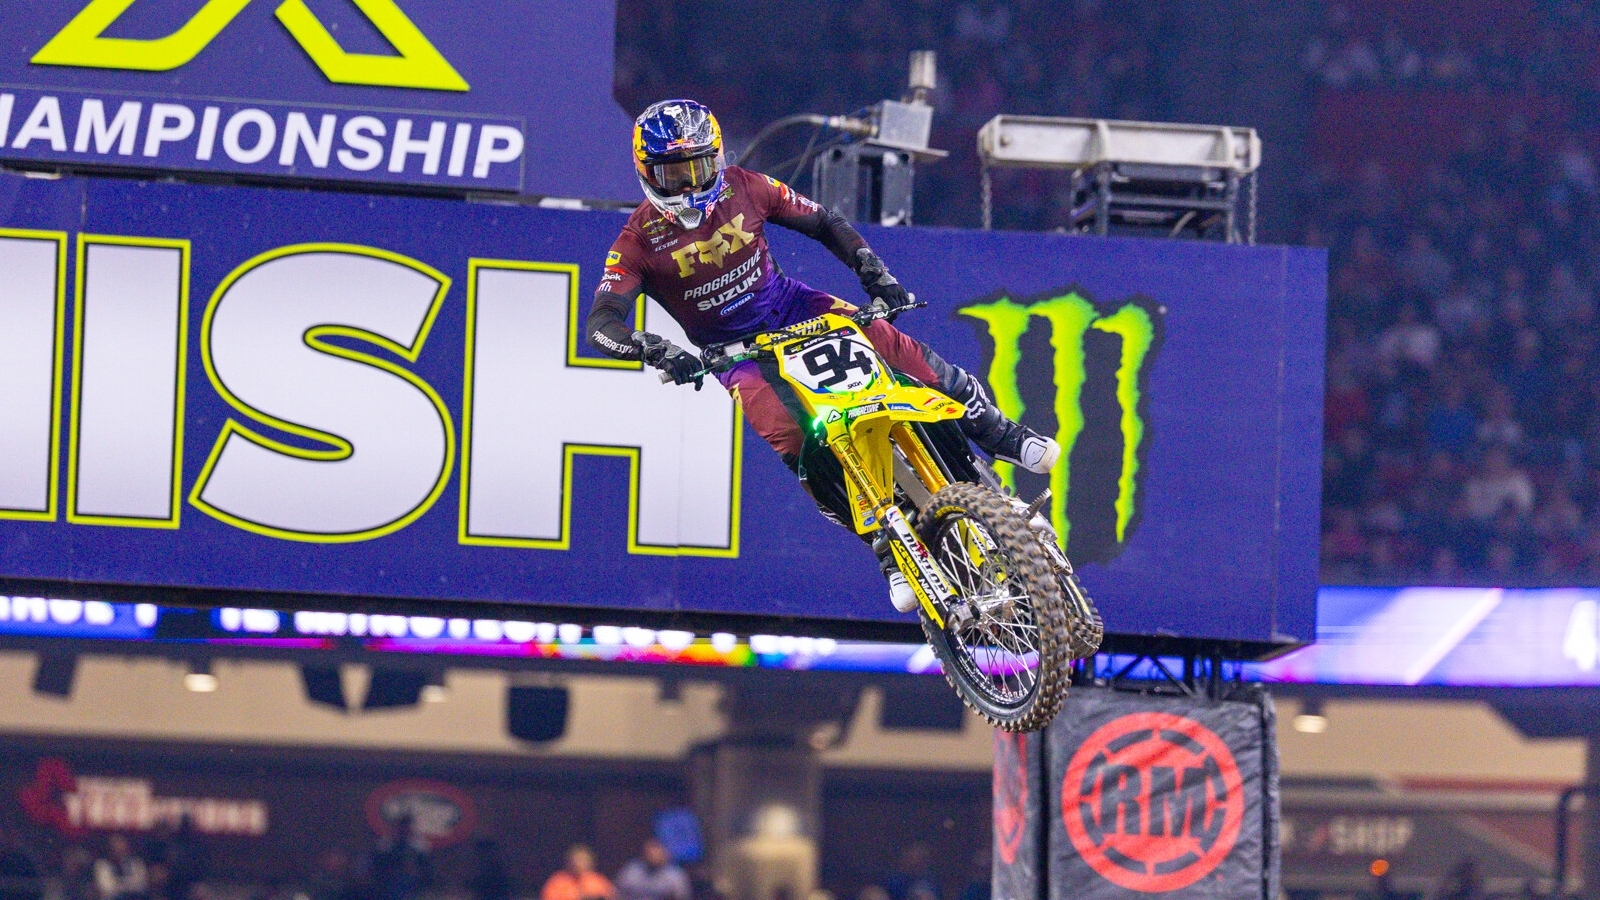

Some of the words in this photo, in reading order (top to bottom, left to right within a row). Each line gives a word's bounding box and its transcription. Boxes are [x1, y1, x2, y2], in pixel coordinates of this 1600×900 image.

[671, 213, 755, 278] FOX
[684, 247, 761, 301] PROGRESSIVE
[697, 266, 762, 311] SUZUKI
[802, 337, 873, 388] 94
[892, 539, 921, 579] ACERBIS
[902, 531, 949, 596] DUNLOP
